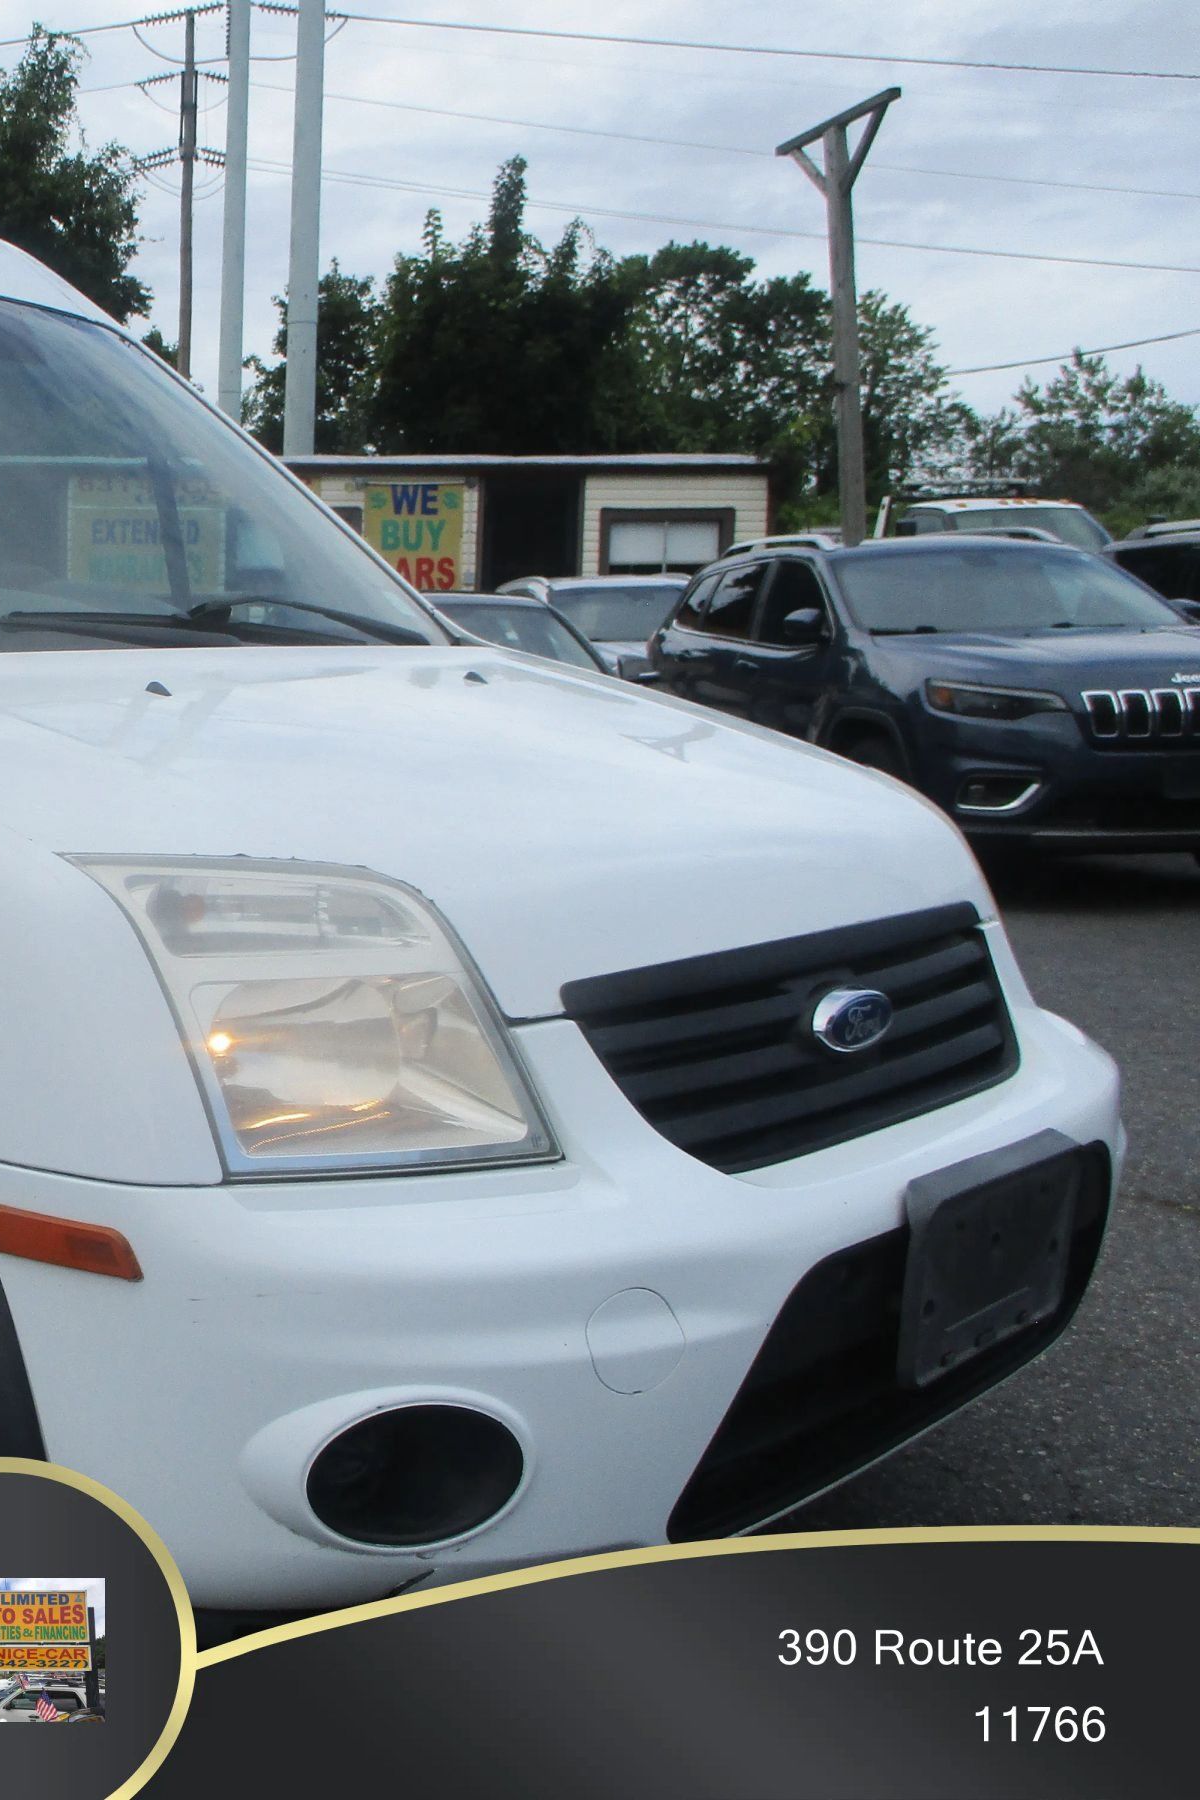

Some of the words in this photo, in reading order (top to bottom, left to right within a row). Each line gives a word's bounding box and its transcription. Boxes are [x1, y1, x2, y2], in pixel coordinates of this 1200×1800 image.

[390, 484, 439, 515] WE
[91, 518, 201, 545] EXTEND
[380, 519, 446, 552] BUY
[395, 557, 455, 591] ARS
